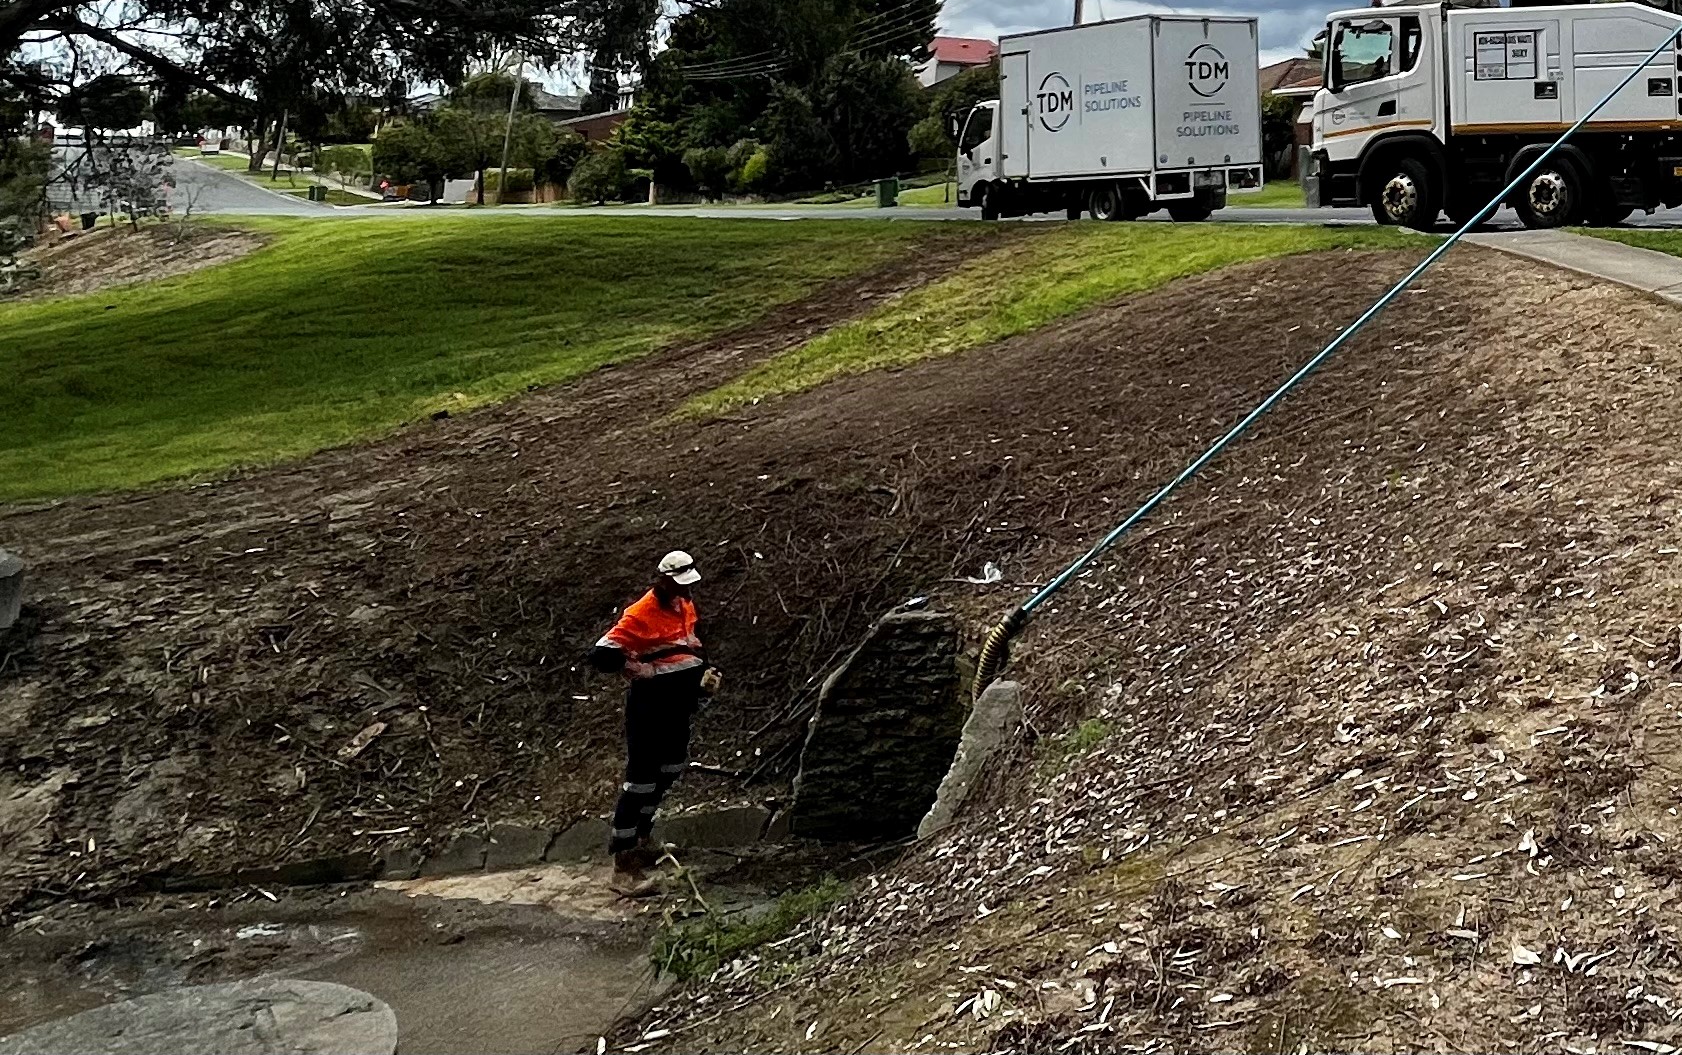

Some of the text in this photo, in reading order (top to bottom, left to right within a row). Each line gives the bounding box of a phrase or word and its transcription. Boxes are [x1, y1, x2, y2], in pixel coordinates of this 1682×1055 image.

[1184, 61, 1229, 80] TDM
[1084, 80, 1128, 95] PIPELINE
[1036, 90, 1073, 114] TDM
[1084, 96, 1141, 112] SOLUTIONS
[1183, 110, 1232, 122] PIPELINE
[1176, 124, 1240, 137] SOLUTIONS
